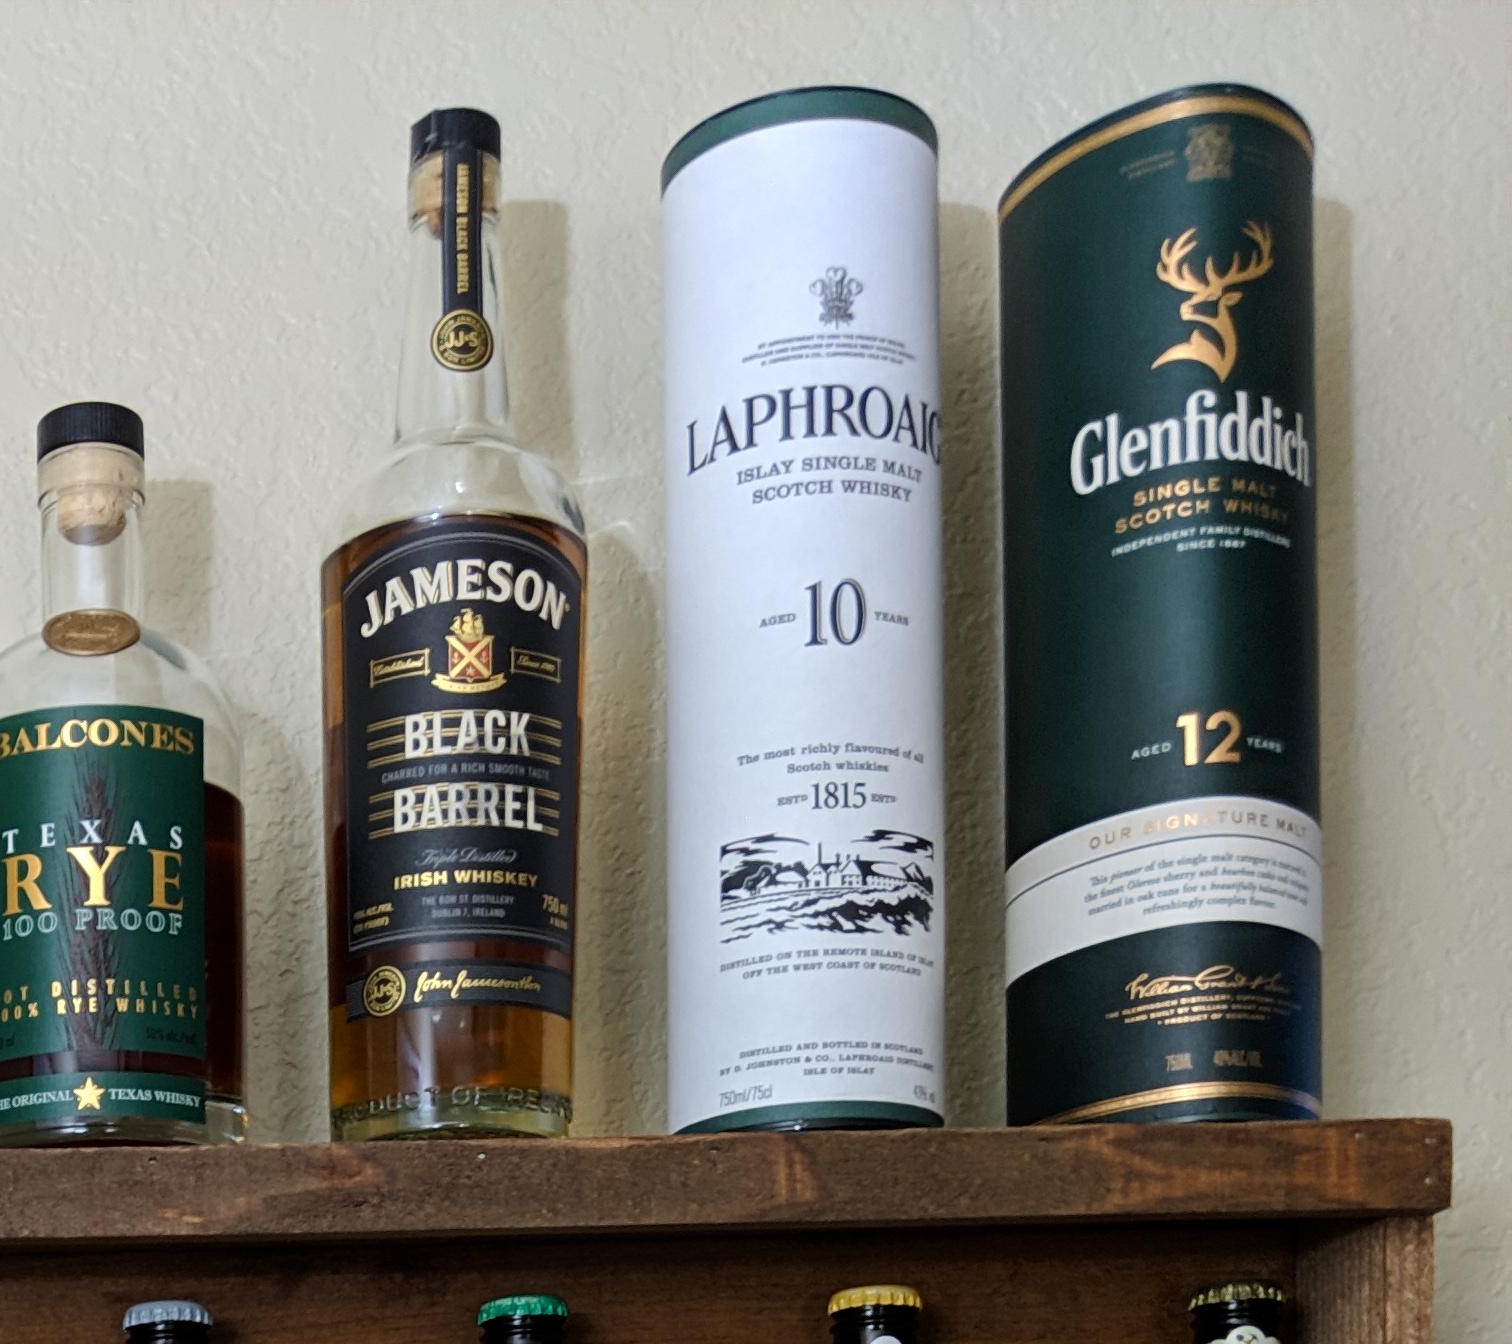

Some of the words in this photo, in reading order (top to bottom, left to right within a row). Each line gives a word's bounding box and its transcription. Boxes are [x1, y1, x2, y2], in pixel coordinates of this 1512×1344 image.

[1069, 389, 1311, 496] Glenfiddich
[737, 460, 795, 485] ISLAY
[802, 455, 876, 473] SINGLE
[883, 460, 922, 482] MALT
[752, 480, 833, 504] SCOTCH
[842, 480, 912, 501] WHISKY
[1133, 476, 1221, 508] SINGLE
[1231, 478, 1277, 498] MALT
[360, 559, 567, 638] JAMESON
[760, 613, 796, 628] AGED
[805, 578, 866, 646] 10
[874, 611, 909, 626] YEARS
[405, 709, 531, 759] BLACK
[1131, 741, 1172, 761] AGED
[1175, 709, 1242, 766] 12
[1246, 736, 1283, 753] YEARS
[787, 761, 830, 775] Scotch
[835, 761, 890, 773] whiskies
[394, 782, 543, 833] BARREL
[2, 818, 183, 854] TEXAS
[1089, 827, 1132, 850] OUR
[1276, 817, 1308, 837] MALT
[2, 845, 184, 917] RYE
[394, 871, 447, 890] IRISH
[454, 870, 538, 887] WHISKEY
